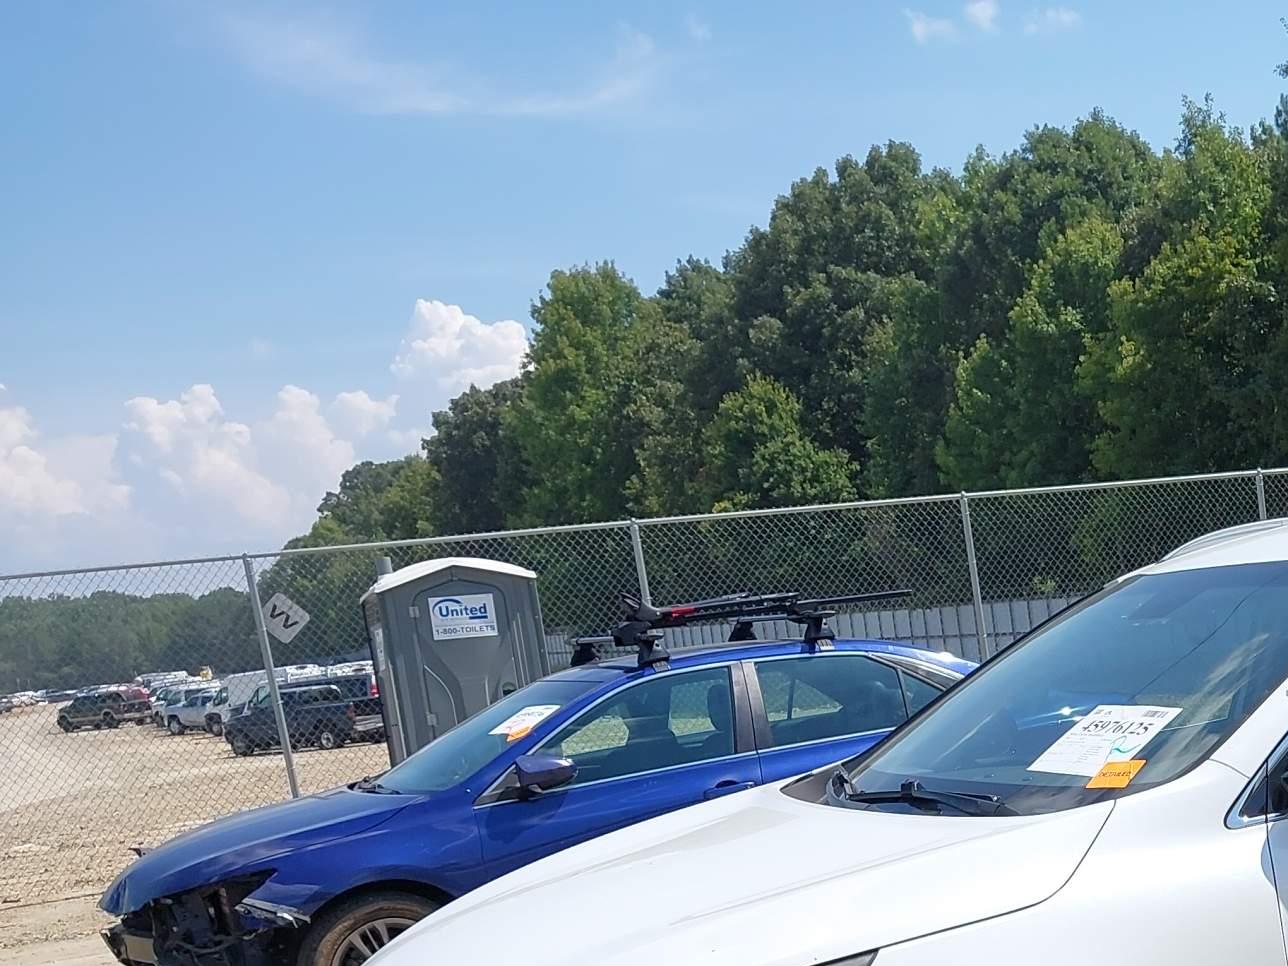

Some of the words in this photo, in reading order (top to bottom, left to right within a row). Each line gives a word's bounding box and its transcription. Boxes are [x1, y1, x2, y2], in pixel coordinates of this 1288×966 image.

[438, 603, 488, 617] United
[435, 625, 496, 636] 1-800-TOILETS
[1082, 720, 1155, 735] 45976125
